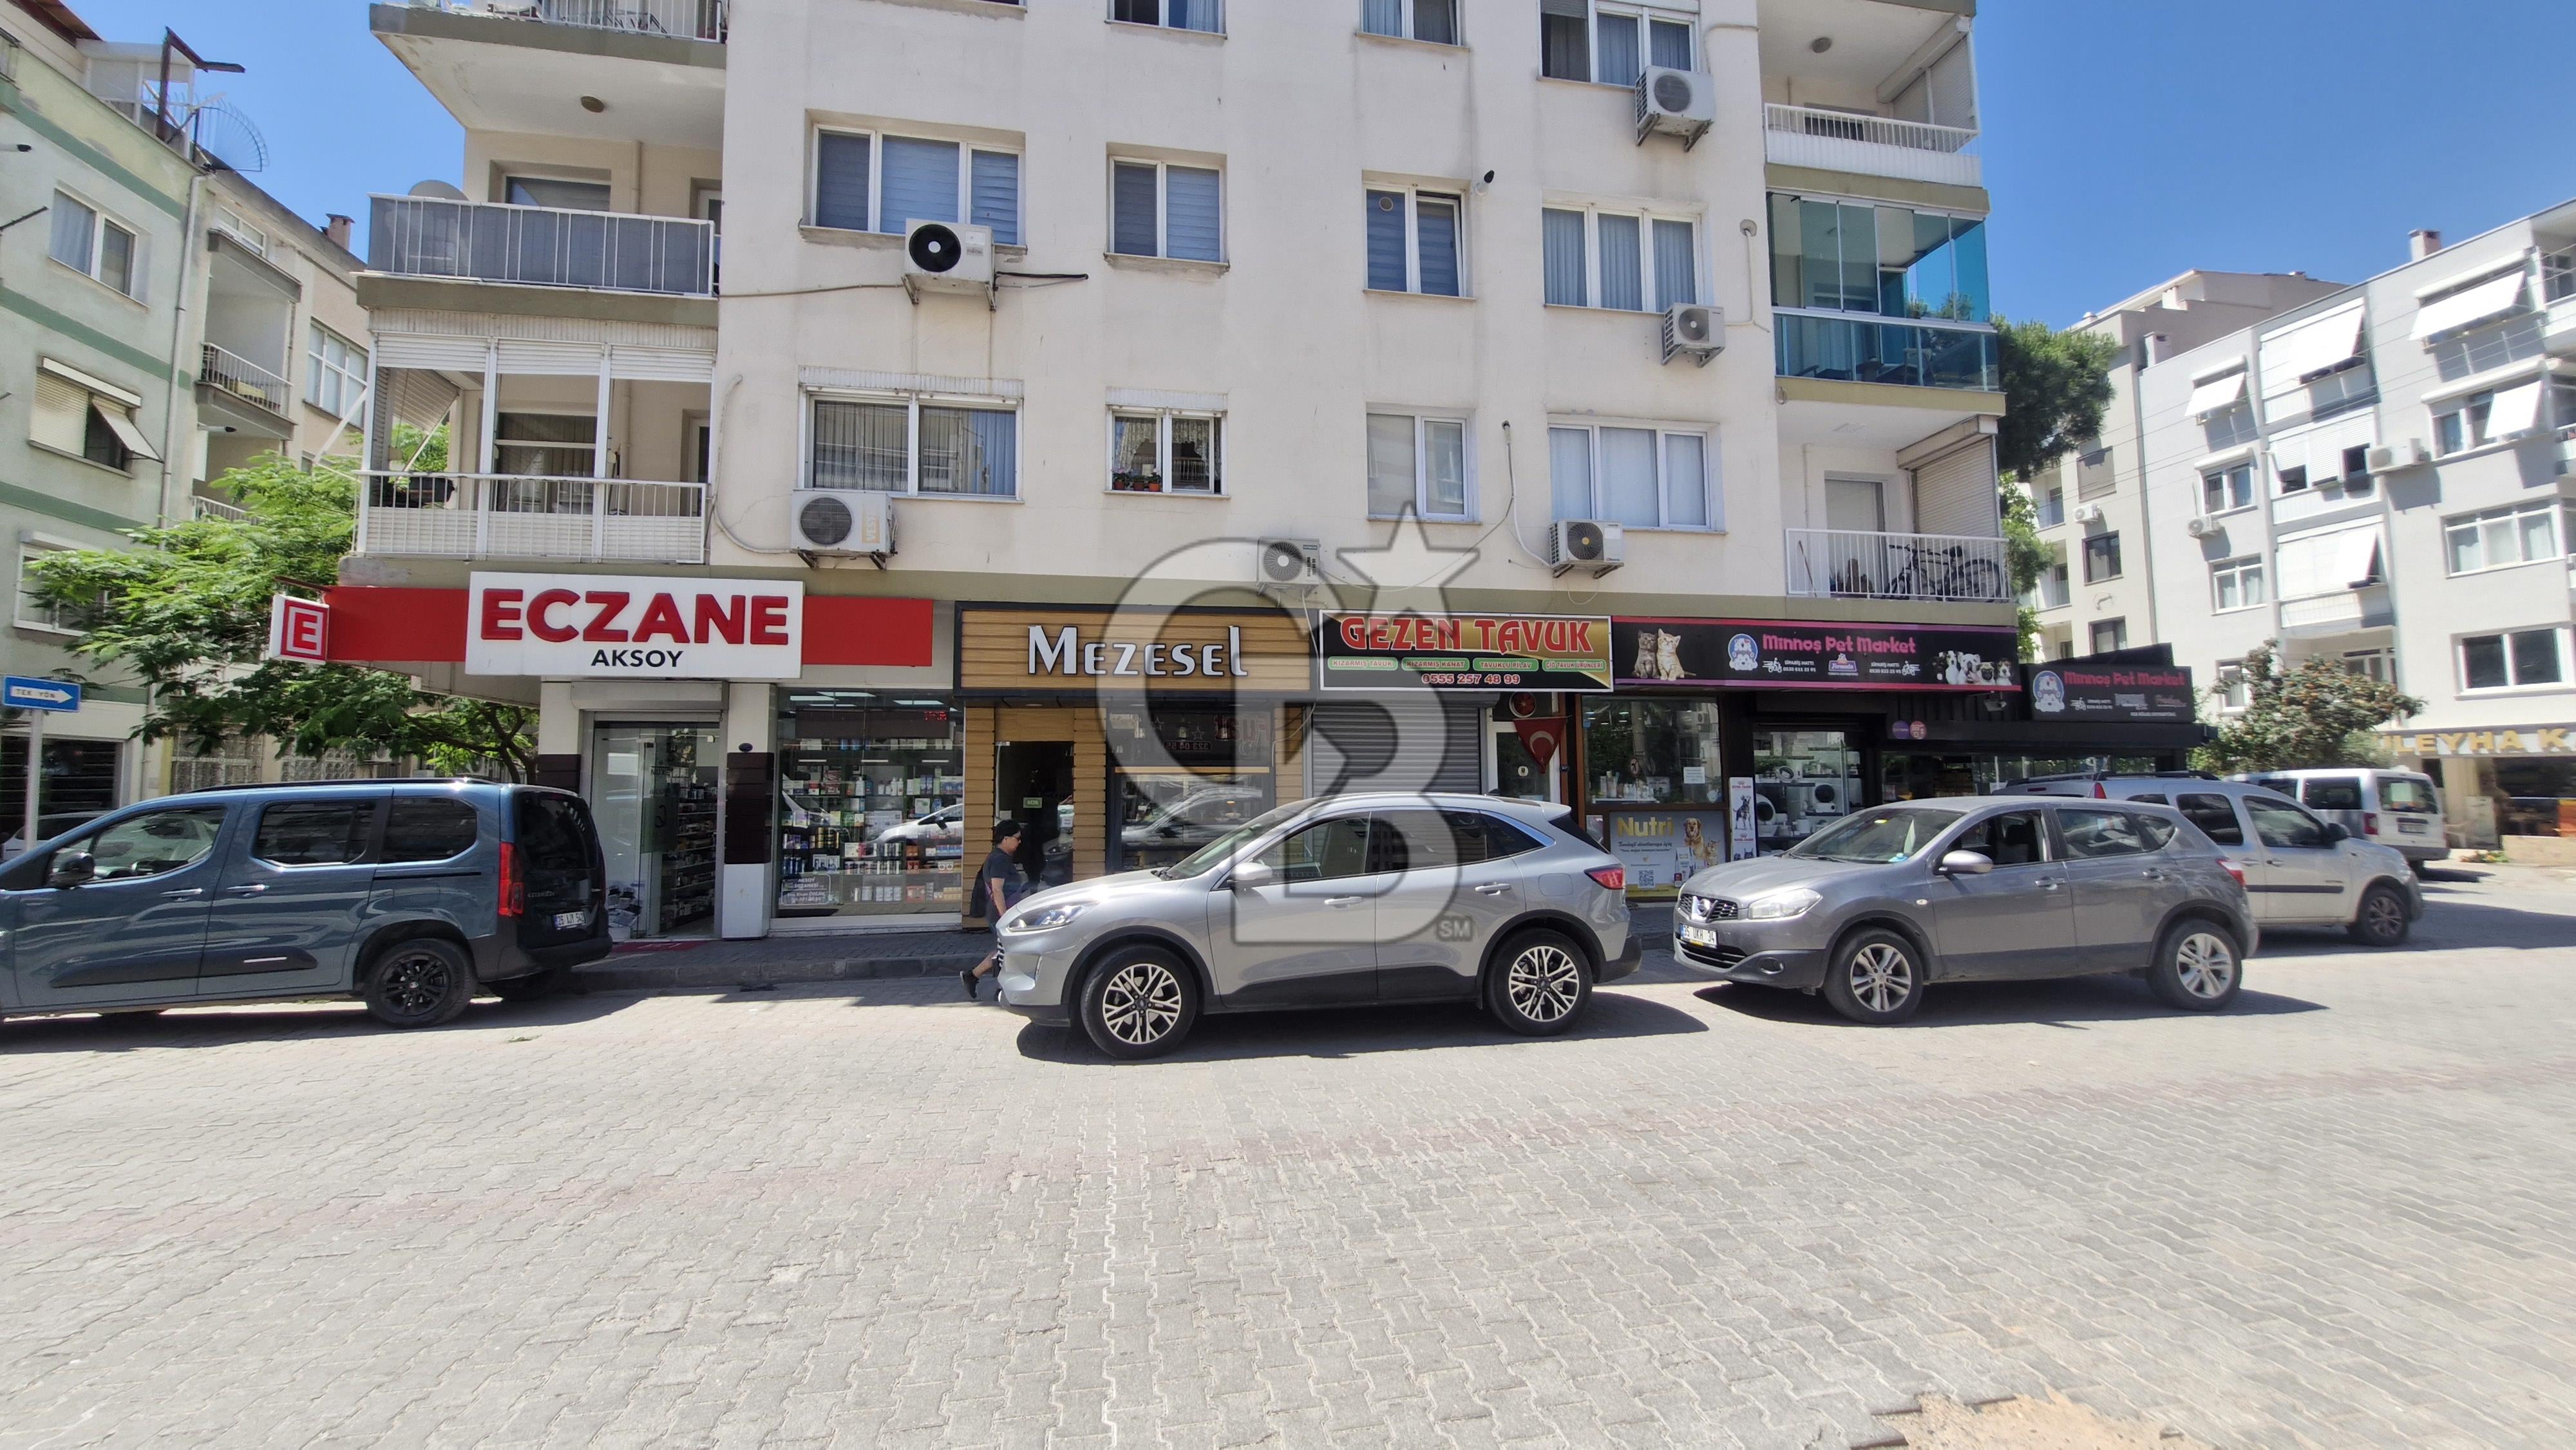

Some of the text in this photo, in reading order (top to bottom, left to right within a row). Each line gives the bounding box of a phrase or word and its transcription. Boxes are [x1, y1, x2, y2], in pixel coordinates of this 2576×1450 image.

[480, 587, 789, 645] ECZANE
[1341, 616, 1594, 655] GEZEN TAVUK
[1762, 634, 1916, 654] Minnoş Pet Market
[590, 648, 684, 668] AKSOY
[1332, 659, 1367, 668] KIZARMIŞ
[1406, 660, 1440, 668] KIZARMIŞ
[1421, 673, 1520, 684] 0555 257 48 99
[2112, 672, 2136, 686] Pet
[1617, 816, 1674, 836] Nutri
